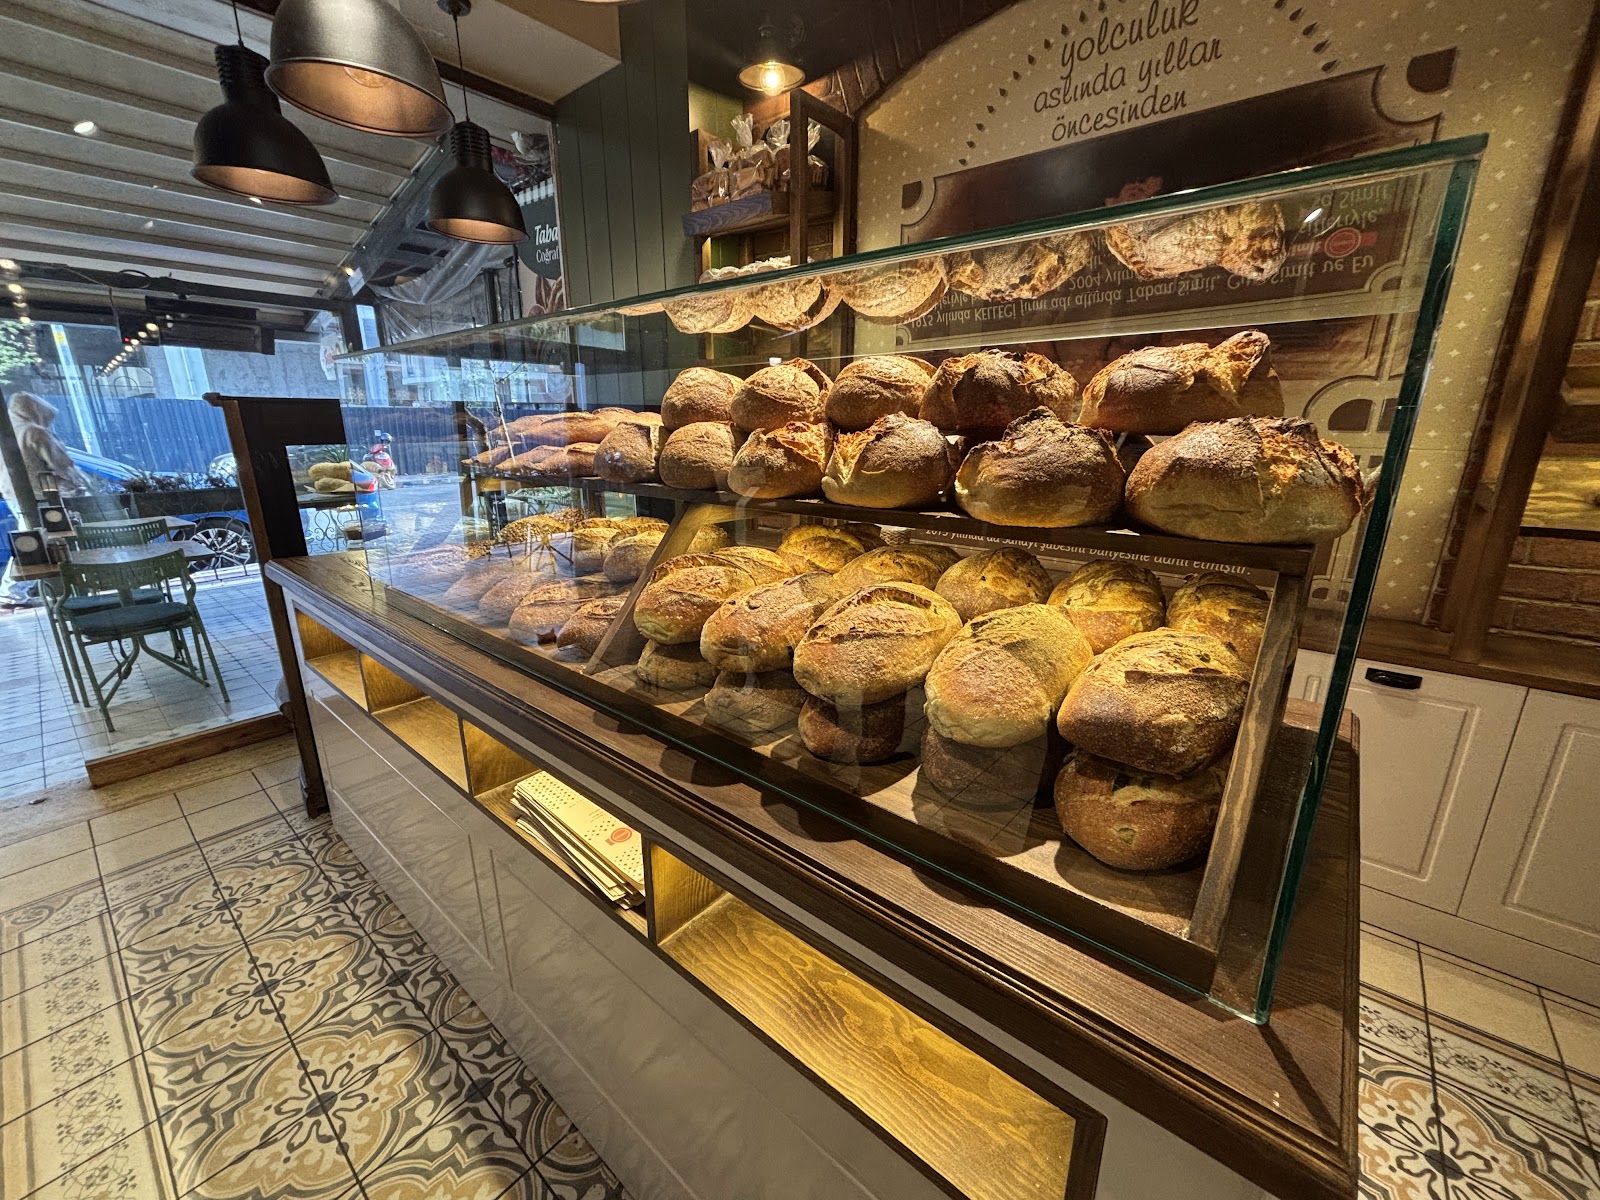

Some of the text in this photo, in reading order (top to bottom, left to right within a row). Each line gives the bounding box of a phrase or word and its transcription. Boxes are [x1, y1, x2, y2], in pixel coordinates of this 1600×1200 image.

[1034, 36, 1222, 114] aslında yıllar
[1061, 0, 1199, 81] yolculuk
[1051, 85, 1187, 142] öncesinden
